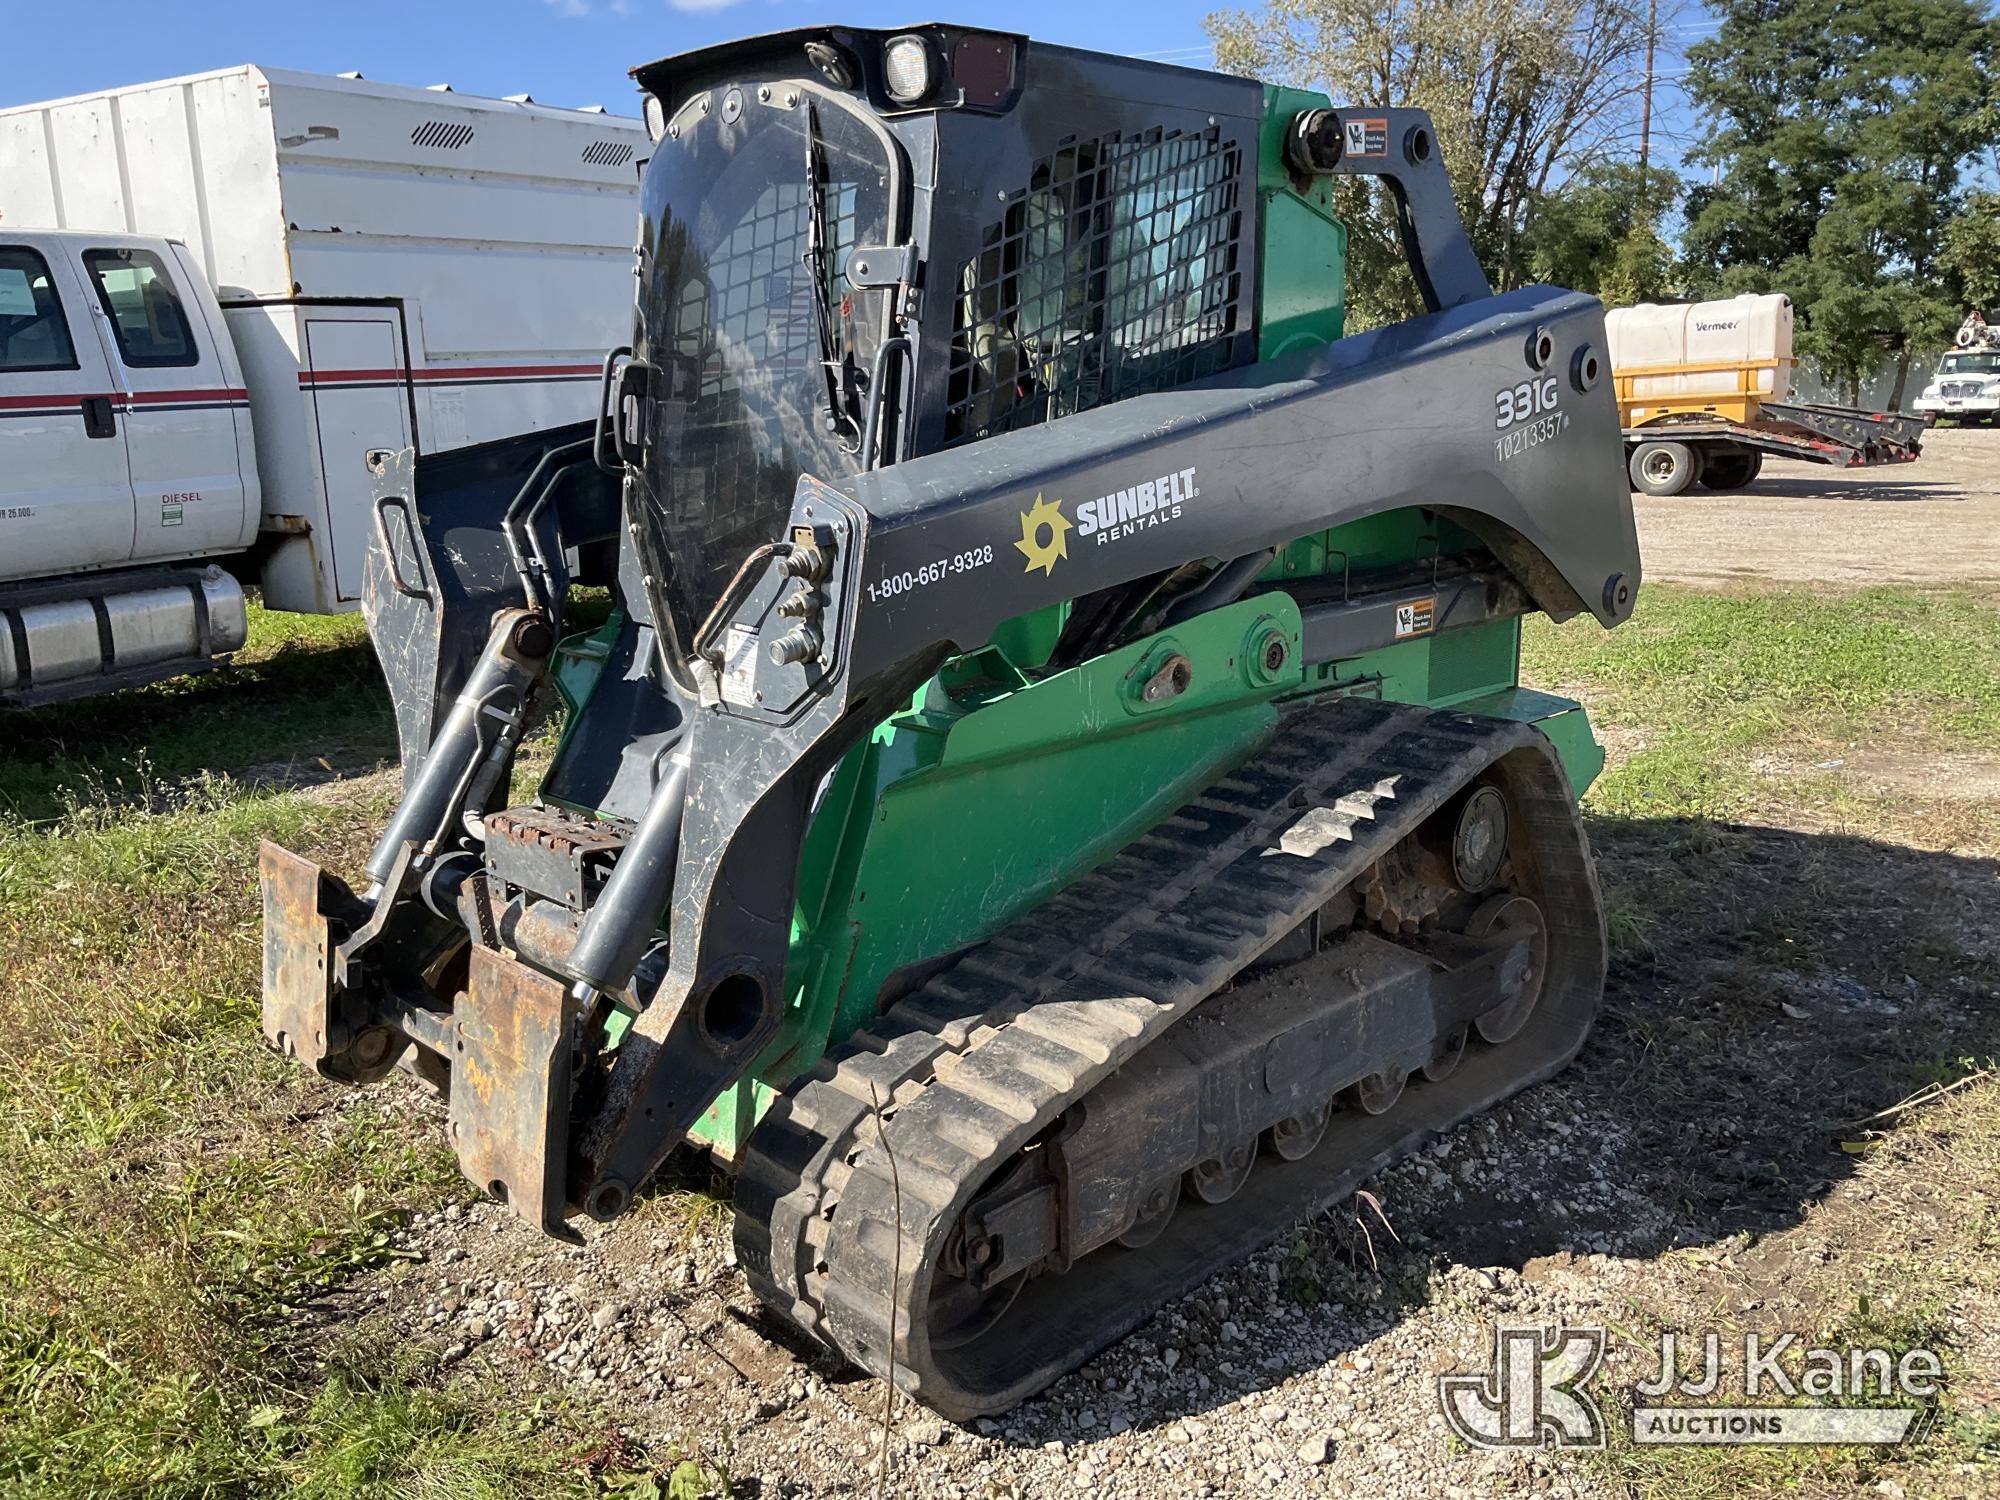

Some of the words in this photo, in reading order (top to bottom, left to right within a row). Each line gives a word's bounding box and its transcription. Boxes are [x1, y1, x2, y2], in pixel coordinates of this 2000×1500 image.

[1696, 320, 1740, 332] Vermeer
[1496, 376, 1559, 429] 331G
[1496, 411, 1563, 462] 10213357
[162, 492, 203, 504] DIESEL
[1097, 505, 1182, 546] RENTALS
[866, 544, 994, 602] 1-800-667-9328
